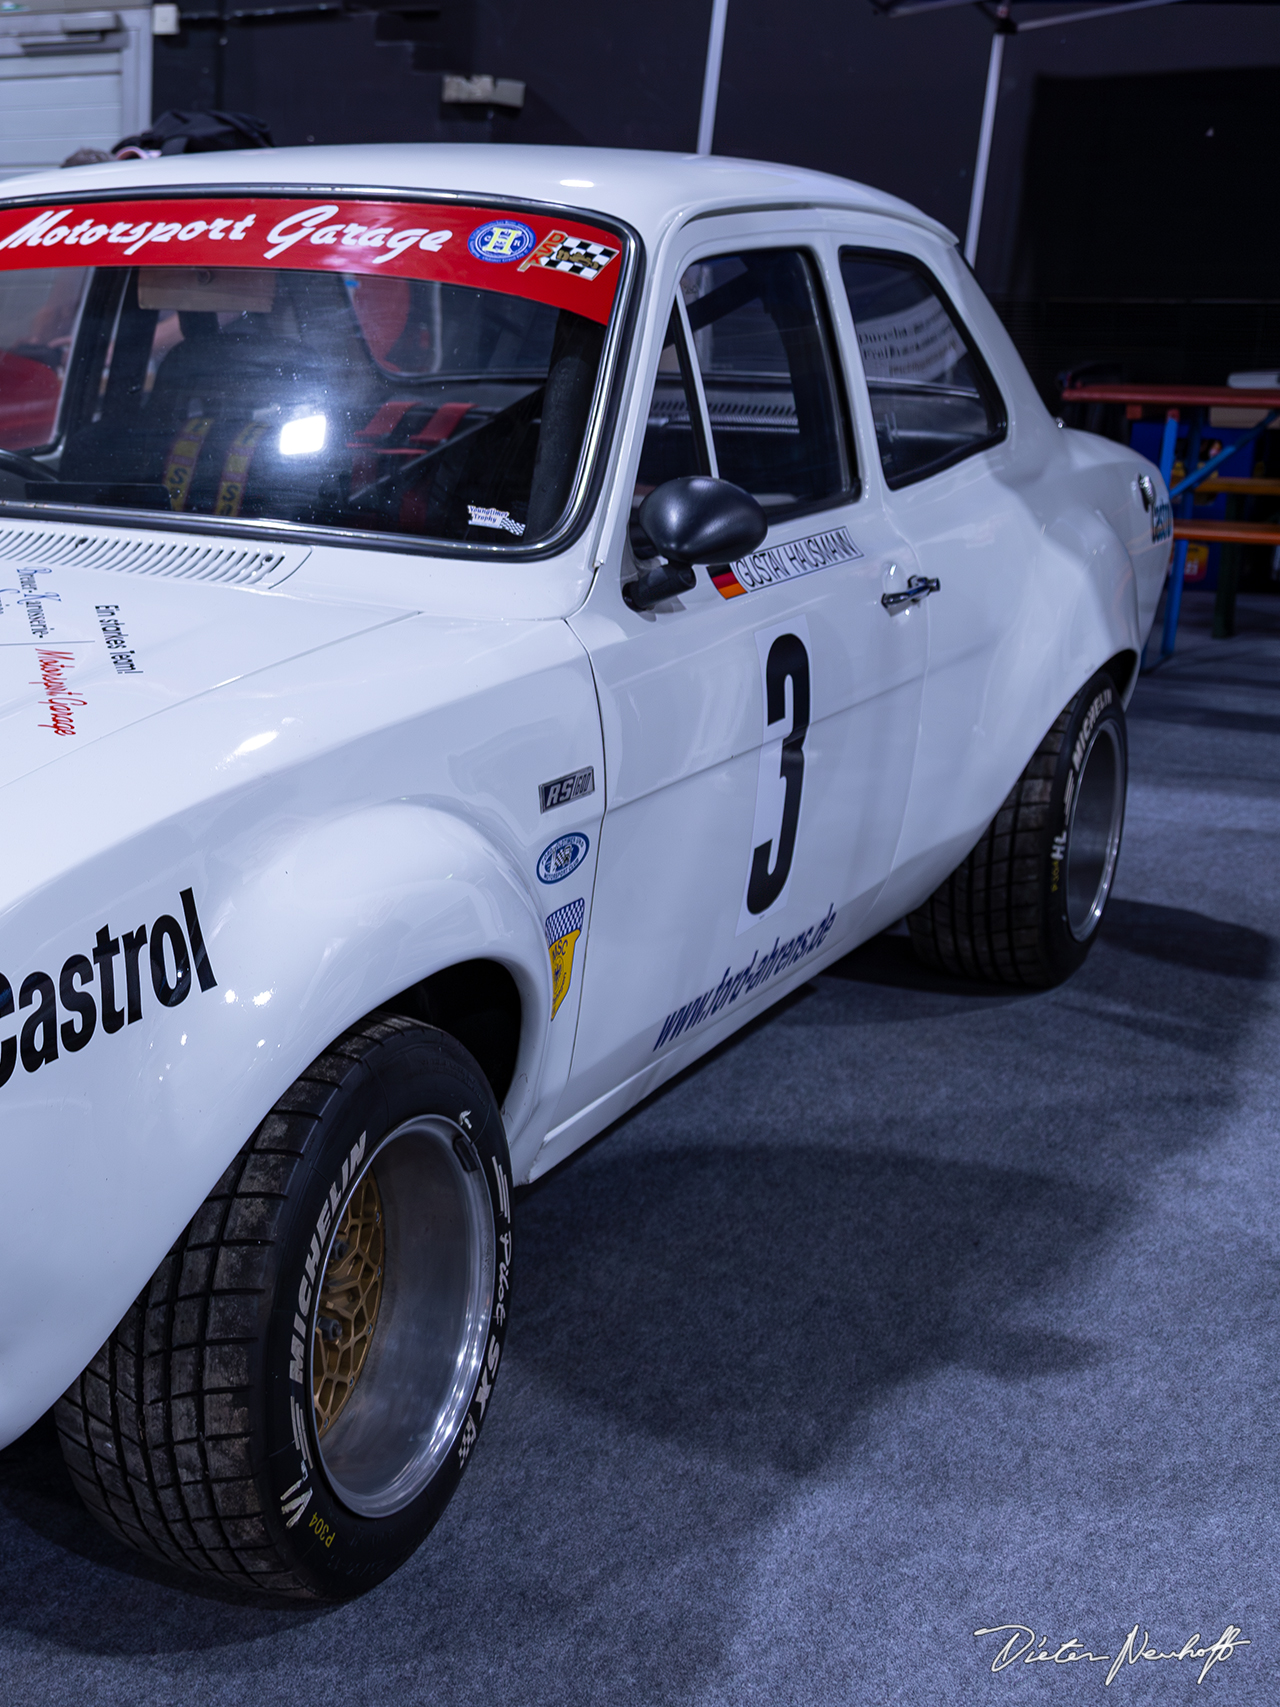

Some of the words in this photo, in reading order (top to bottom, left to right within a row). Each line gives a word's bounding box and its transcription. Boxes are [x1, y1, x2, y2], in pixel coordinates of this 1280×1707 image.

[263, 204, 454, 264] Garage
[527, 233, 565, 265] DSK
[469, 505, 509, 518] Youngtimer
[473, 512, 498, 524] Trophy
[734, 548, 791, 588] GUSTAV
[783, 529, 859, 573] HAUSMANN
[95, 604, 120, 618] Ein
[99, 618, 129, 650] starkes
[28, 647, 84, 697] Motorsport
[110, 649, 144, 675] Team!
[37, 697, 89, 737] Garage
[1072, 688, 1113, 772] MICHELIN
[546, 777, 574, 807] RS
[571, 771, 593, 797] 1600
[746, 632, 811, 916] 3
[653, 902, 837, 1052] www.ford-ahrens.de
[289, 1130, 367, 1385] MICHELIN
[493, 1230, 513, 1328] Pilot
[308, 1511, 336, 1549] P304
